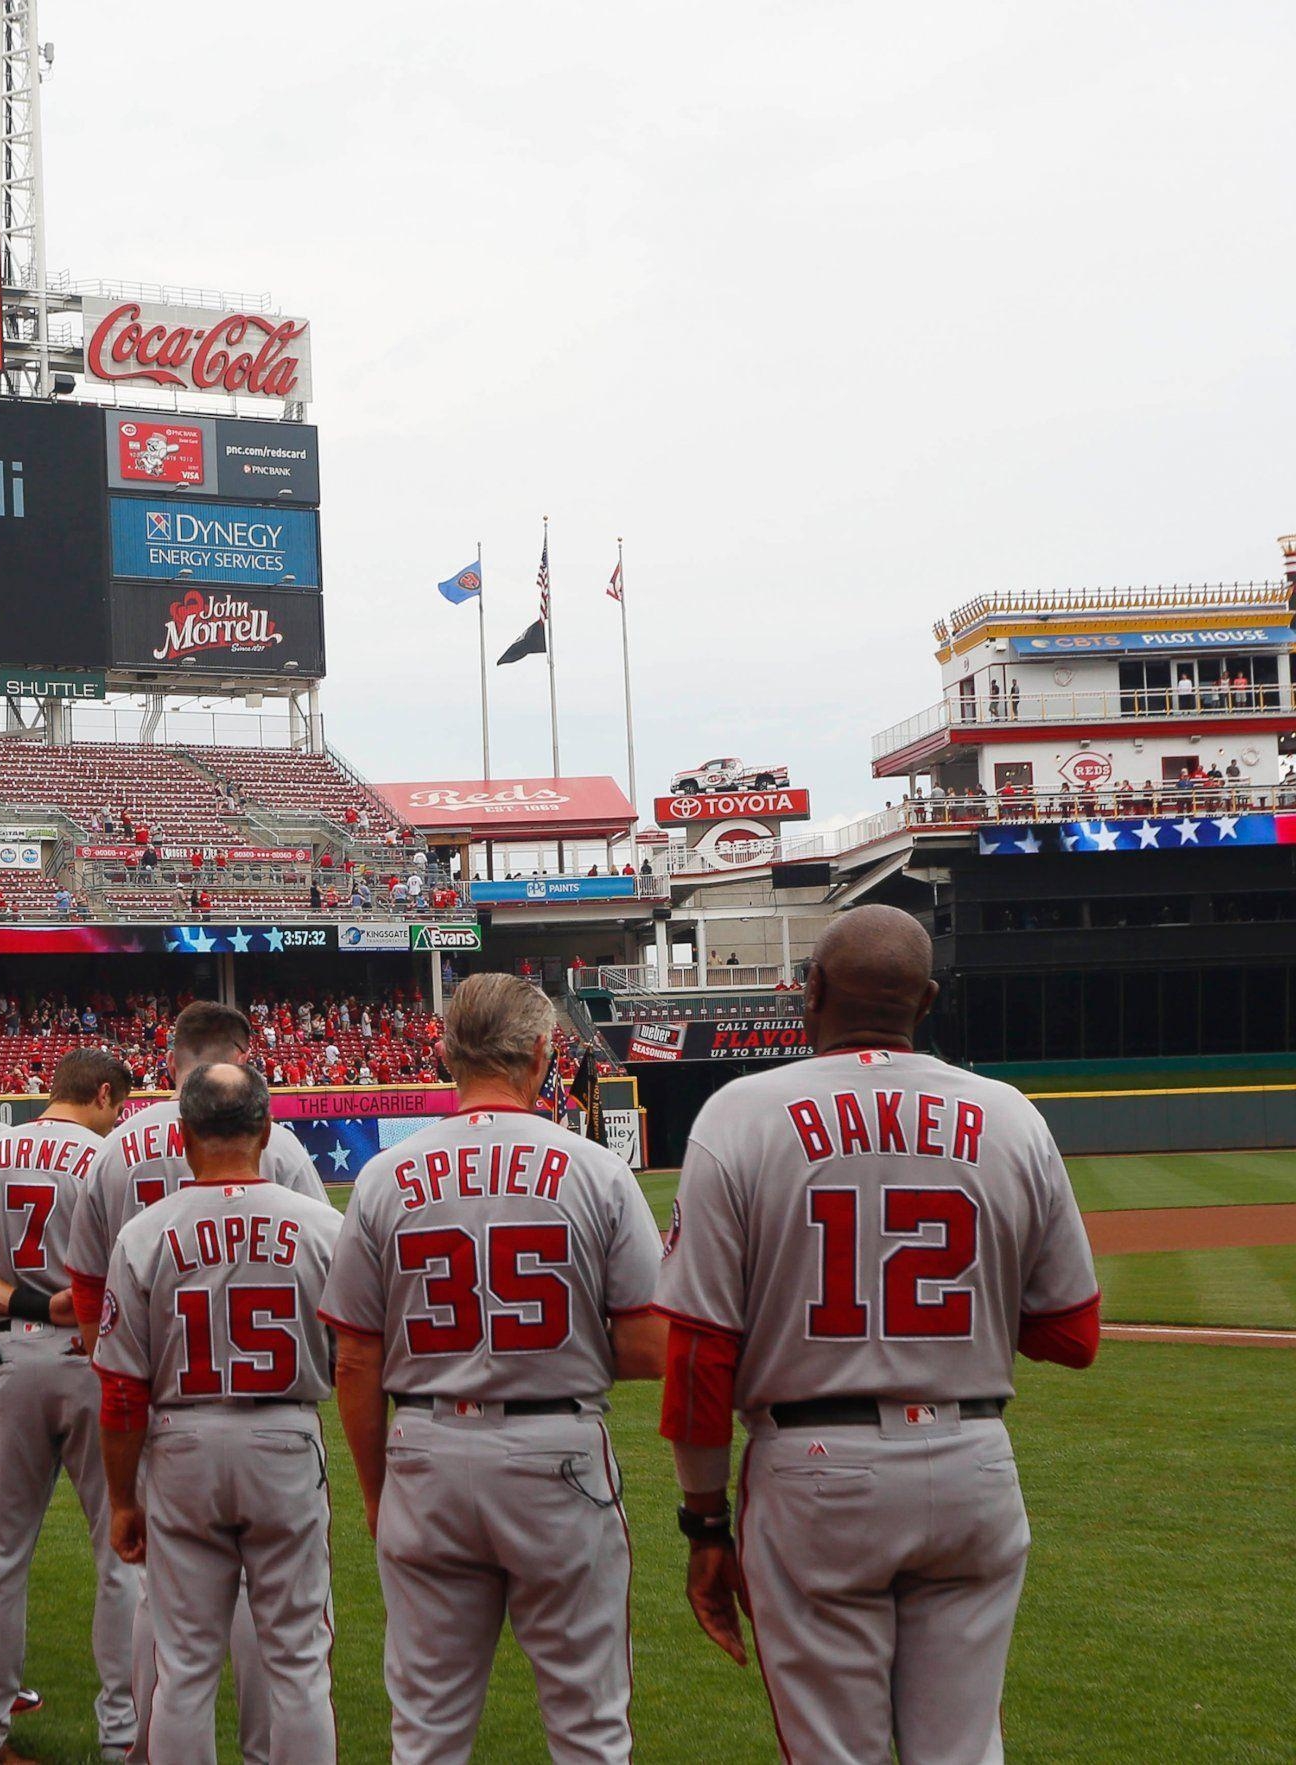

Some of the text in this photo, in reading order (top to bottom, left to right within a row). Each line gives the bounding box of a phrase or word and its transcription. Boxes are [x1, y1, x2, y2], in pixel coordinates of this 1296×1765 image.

[225, 444, 307, 460] pnc.com/redscard
[181, 471, 200, 480] VISA
[176, 513, 284, 549] DYNEGY
[149, 548, 284, 572] ENERGY SERVICES
[200, 594, 250, 620] John
[153, 609, 284, 660] Morrell
[1055, 629, 1269, 648] CBTS PILOT HOUSE
[6, 680, 96, 698] SHUTTLE
[1073, 764, 1112, 777] REDS
[409, 784, 570, 809] Reds
[704, 794, 794, 814] TOYOTA
[548, 882, 580, 894] PAINTS
[283, 929, 327, 946] 3:57:32
[366, 929, 408, 938] KINGSGATE
[431, 928, 476, 946] Evans
[640, 1023, 671, 1043] weber
[716, 1022, 749, 1032] CALL
[631, 1042, 678, 1061] SEASONINGS
[710, 1046, 815, 1058] UP TO THE BIGS
[299, 1095, 425, 1114] THE UN-CARRIER
[784, 1088, 986, 1167] BAKER
[394, 1144, 572, 1212] SPEIER
[5, 1182, 58, 1273] 7
[165, 1214, 301, 1276] LOPES
[804, 1184, 980, 1343] 12
[395, 1221, 575, 1358] 35
[174, 1283, 300, 1398] 15
